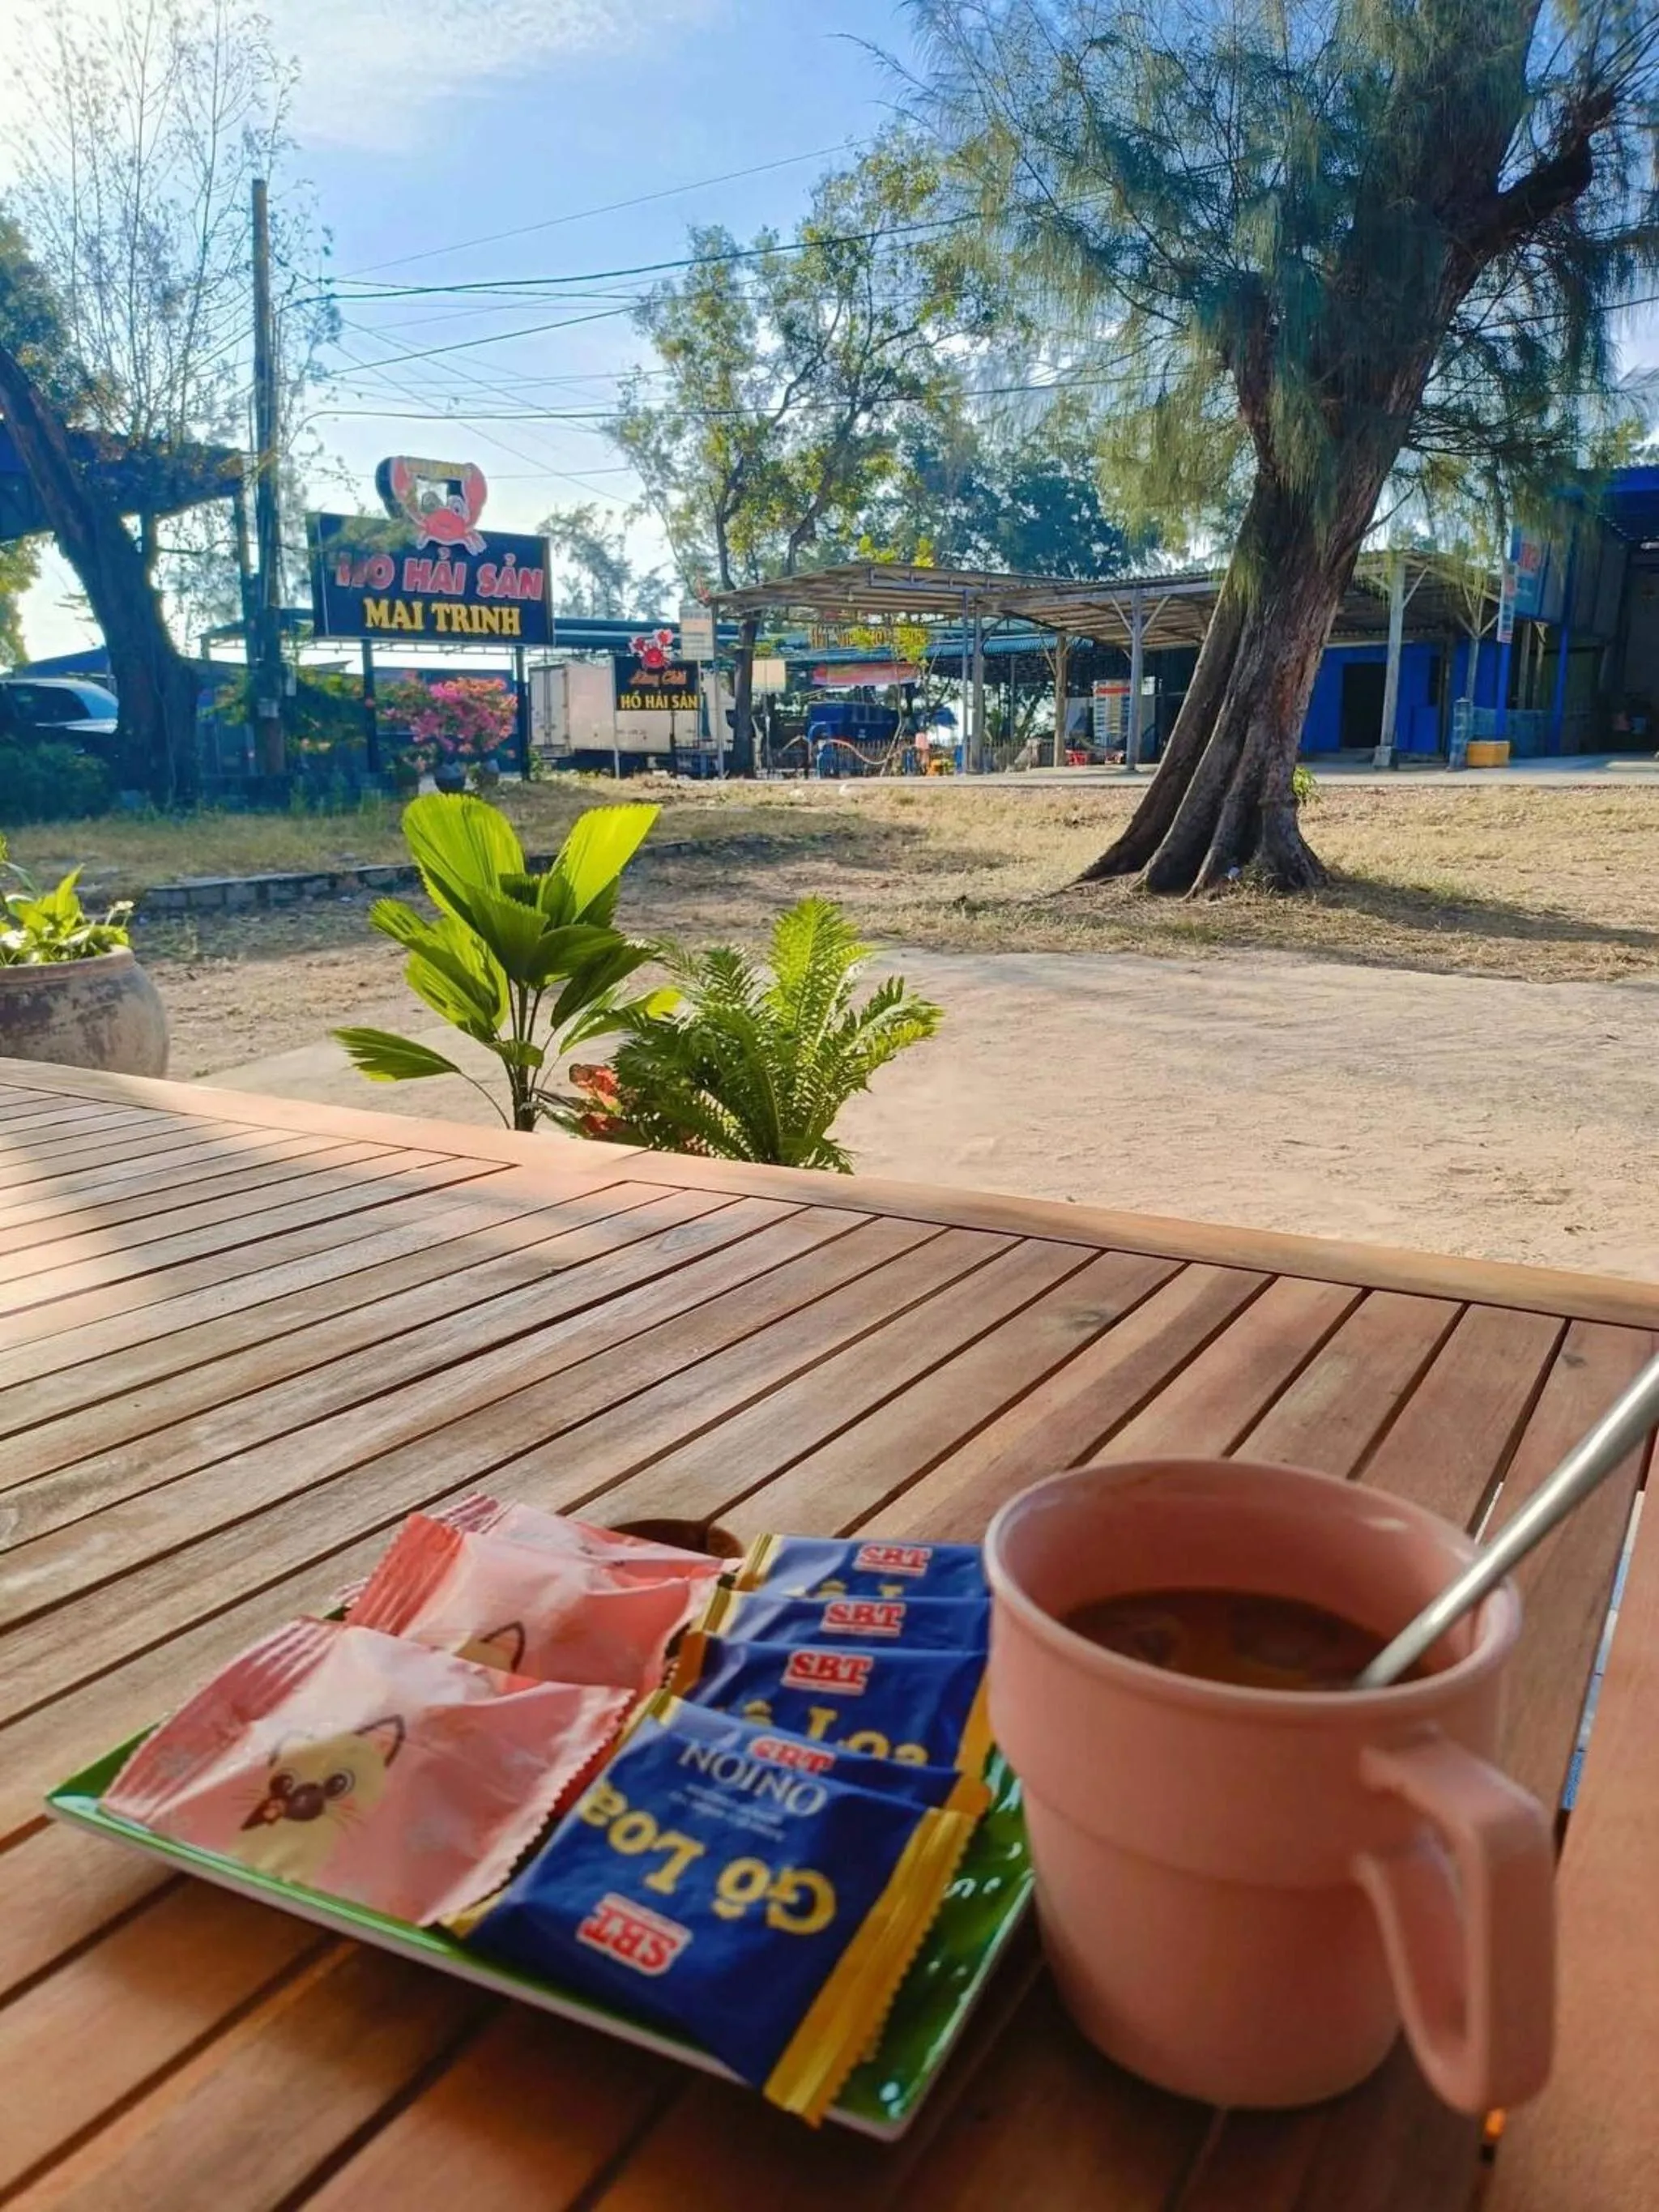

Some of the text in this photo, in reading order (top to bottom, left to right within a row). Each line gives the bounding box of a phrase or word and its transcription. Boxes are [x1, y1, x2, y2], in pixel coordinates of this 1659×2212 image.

[402, 547, 467, 595] HẢI
[476, 552, 544, 601] SẢN
[364, 597, 521, 636] MAI TRINH
[645, 689, 668, 709] HẢI
[672, 689, 697, 709] SẢN
[856, 1544, 931, 1571] SBT
[825, 1601, 906, 1630] SBT
[788, 1650, 872, 1686] SBT
[677, 1744, 828, 1817] ONION
[579, 1781, 706, 1895] Loa
[580, 1903, 682, 1971] SBT
